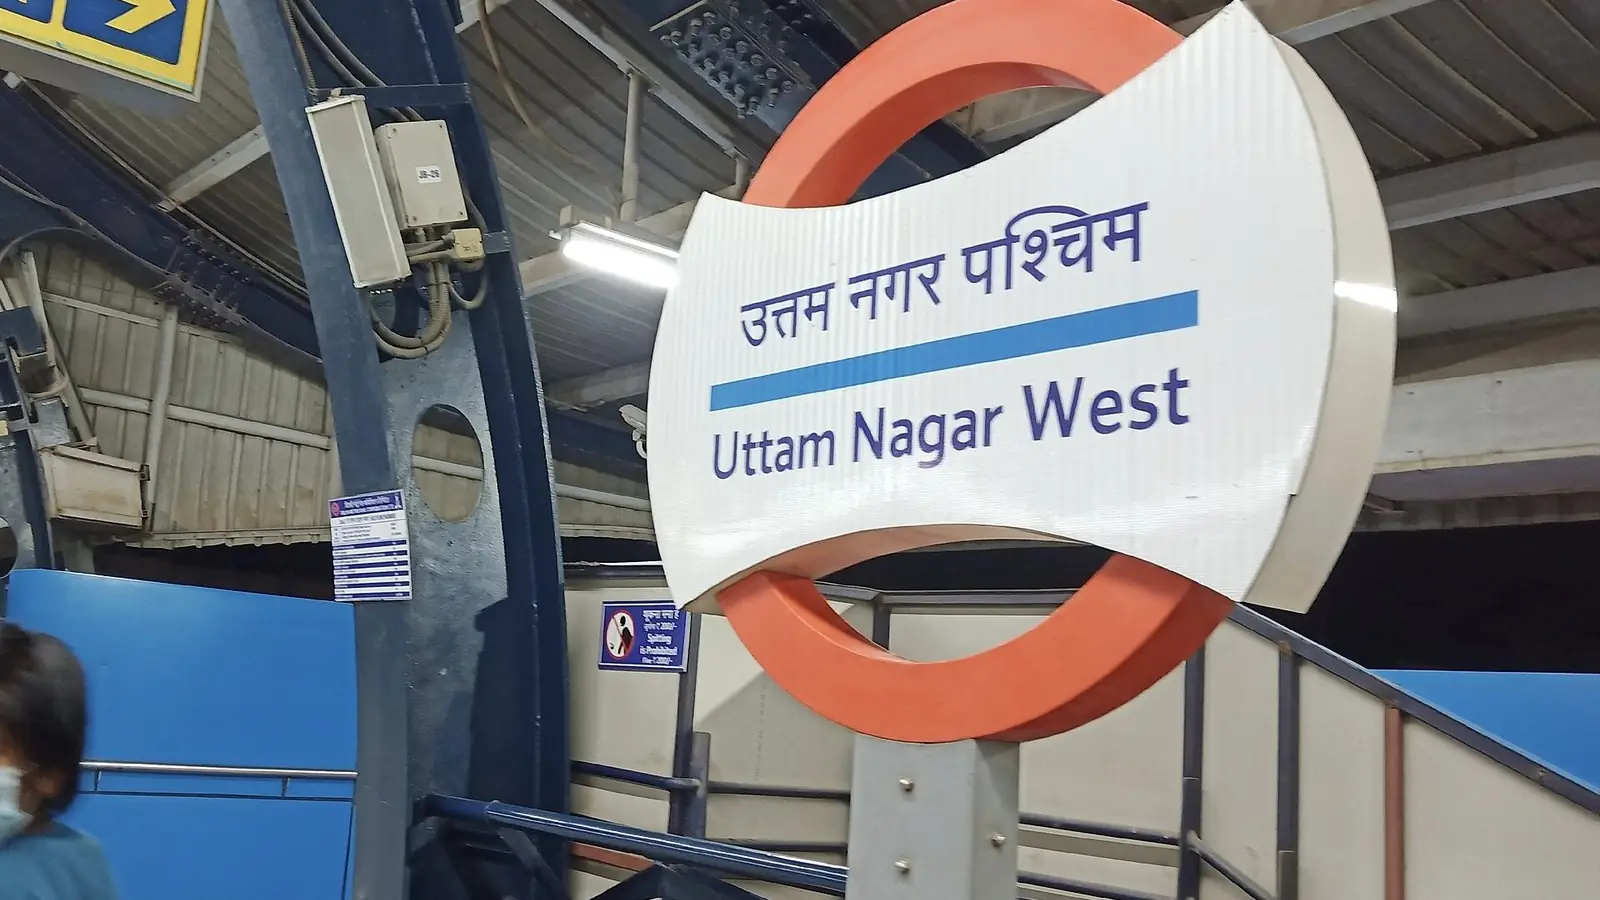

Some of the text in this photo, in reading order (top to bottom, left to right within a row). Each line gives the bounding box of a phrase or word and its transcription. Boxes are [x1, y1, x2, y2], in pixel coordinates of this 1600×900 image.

[740, 203, 1149, 347] उत्तम नगर पश्चिम
[712, 367, 1190, 479] Uttam Nagar West
[646, 645, 678, 655] Prohibited
[647, 633, 672, 645] Spitting
